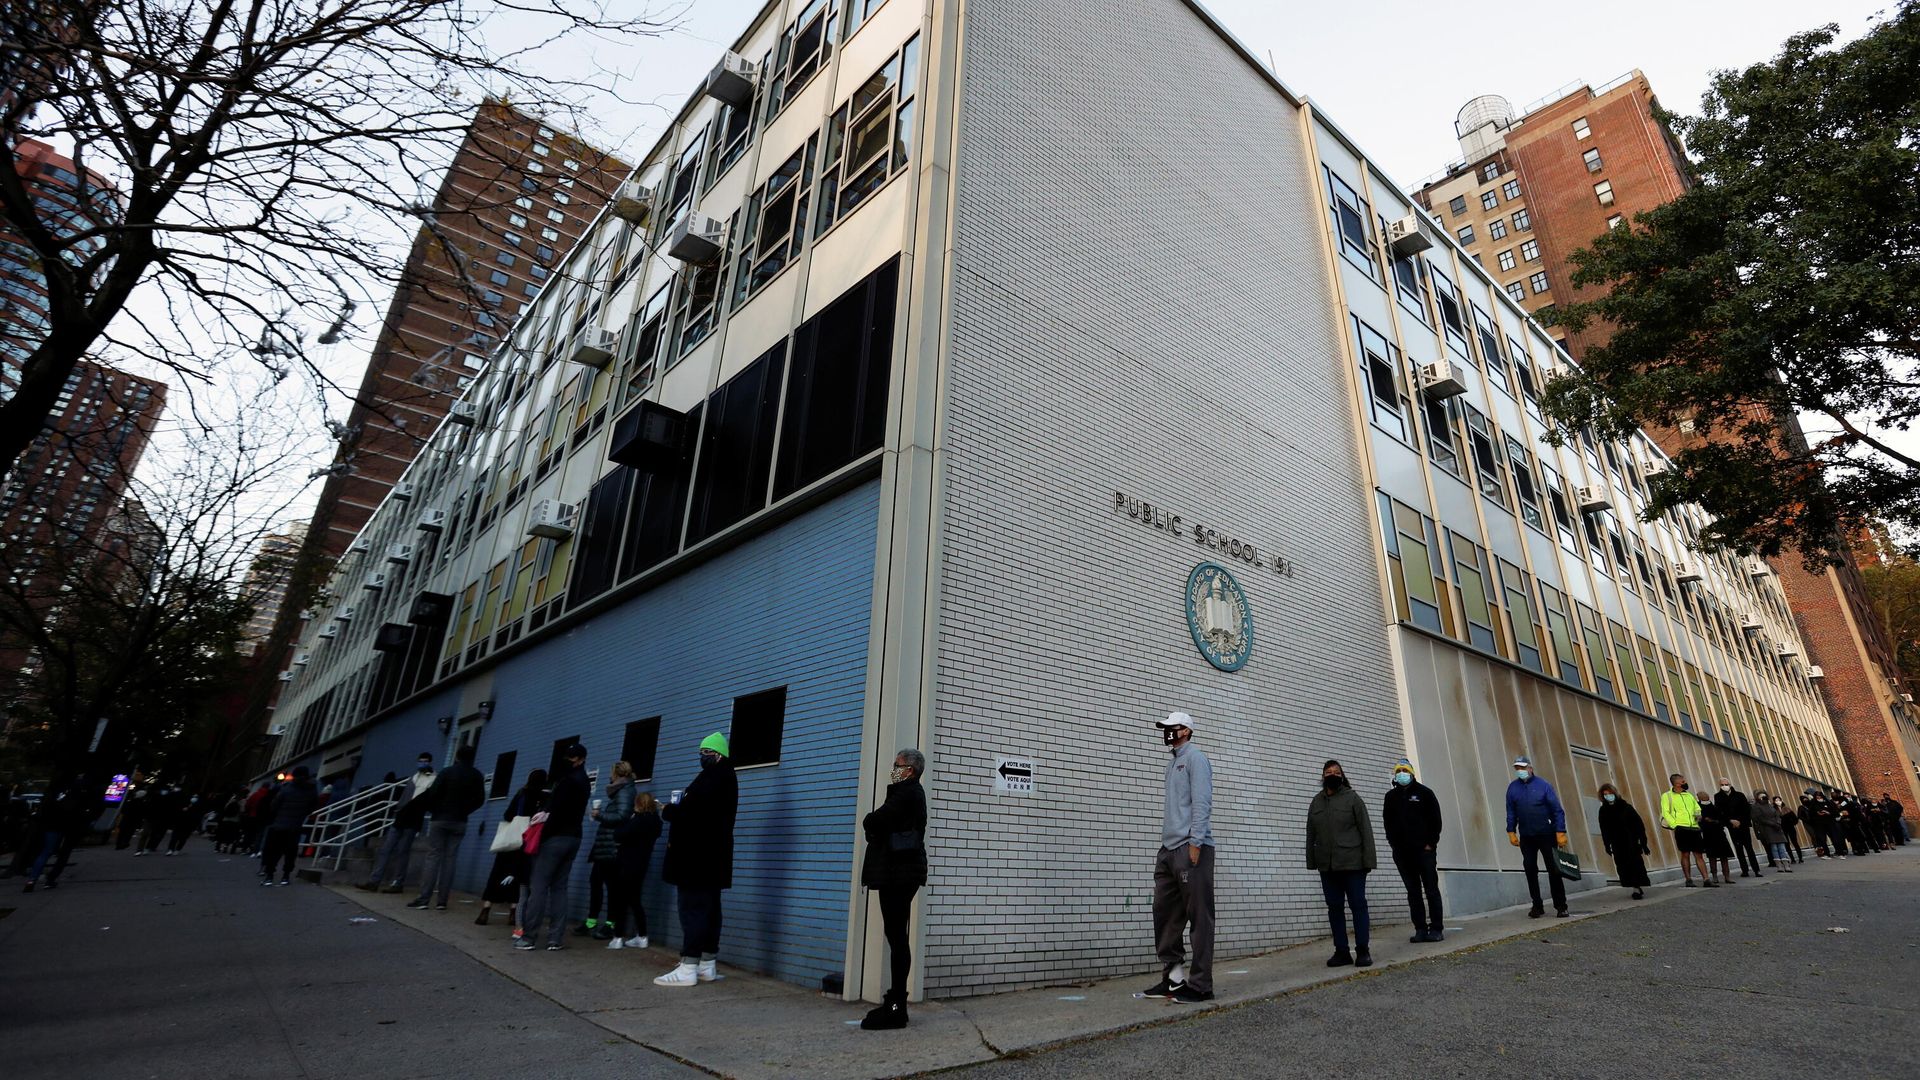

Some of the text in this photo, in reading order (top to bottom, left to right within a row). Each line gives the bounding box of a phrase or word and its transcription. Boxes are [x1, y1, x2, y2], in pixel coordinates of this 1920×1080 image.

[1113, 491, 1183, 536] PUBLIC
[1194, 524, 1263, 567] SCHOOL
[1217, 571, 1248, 618] EDUCATION
[1220, 655, 1237, 665] NEW
